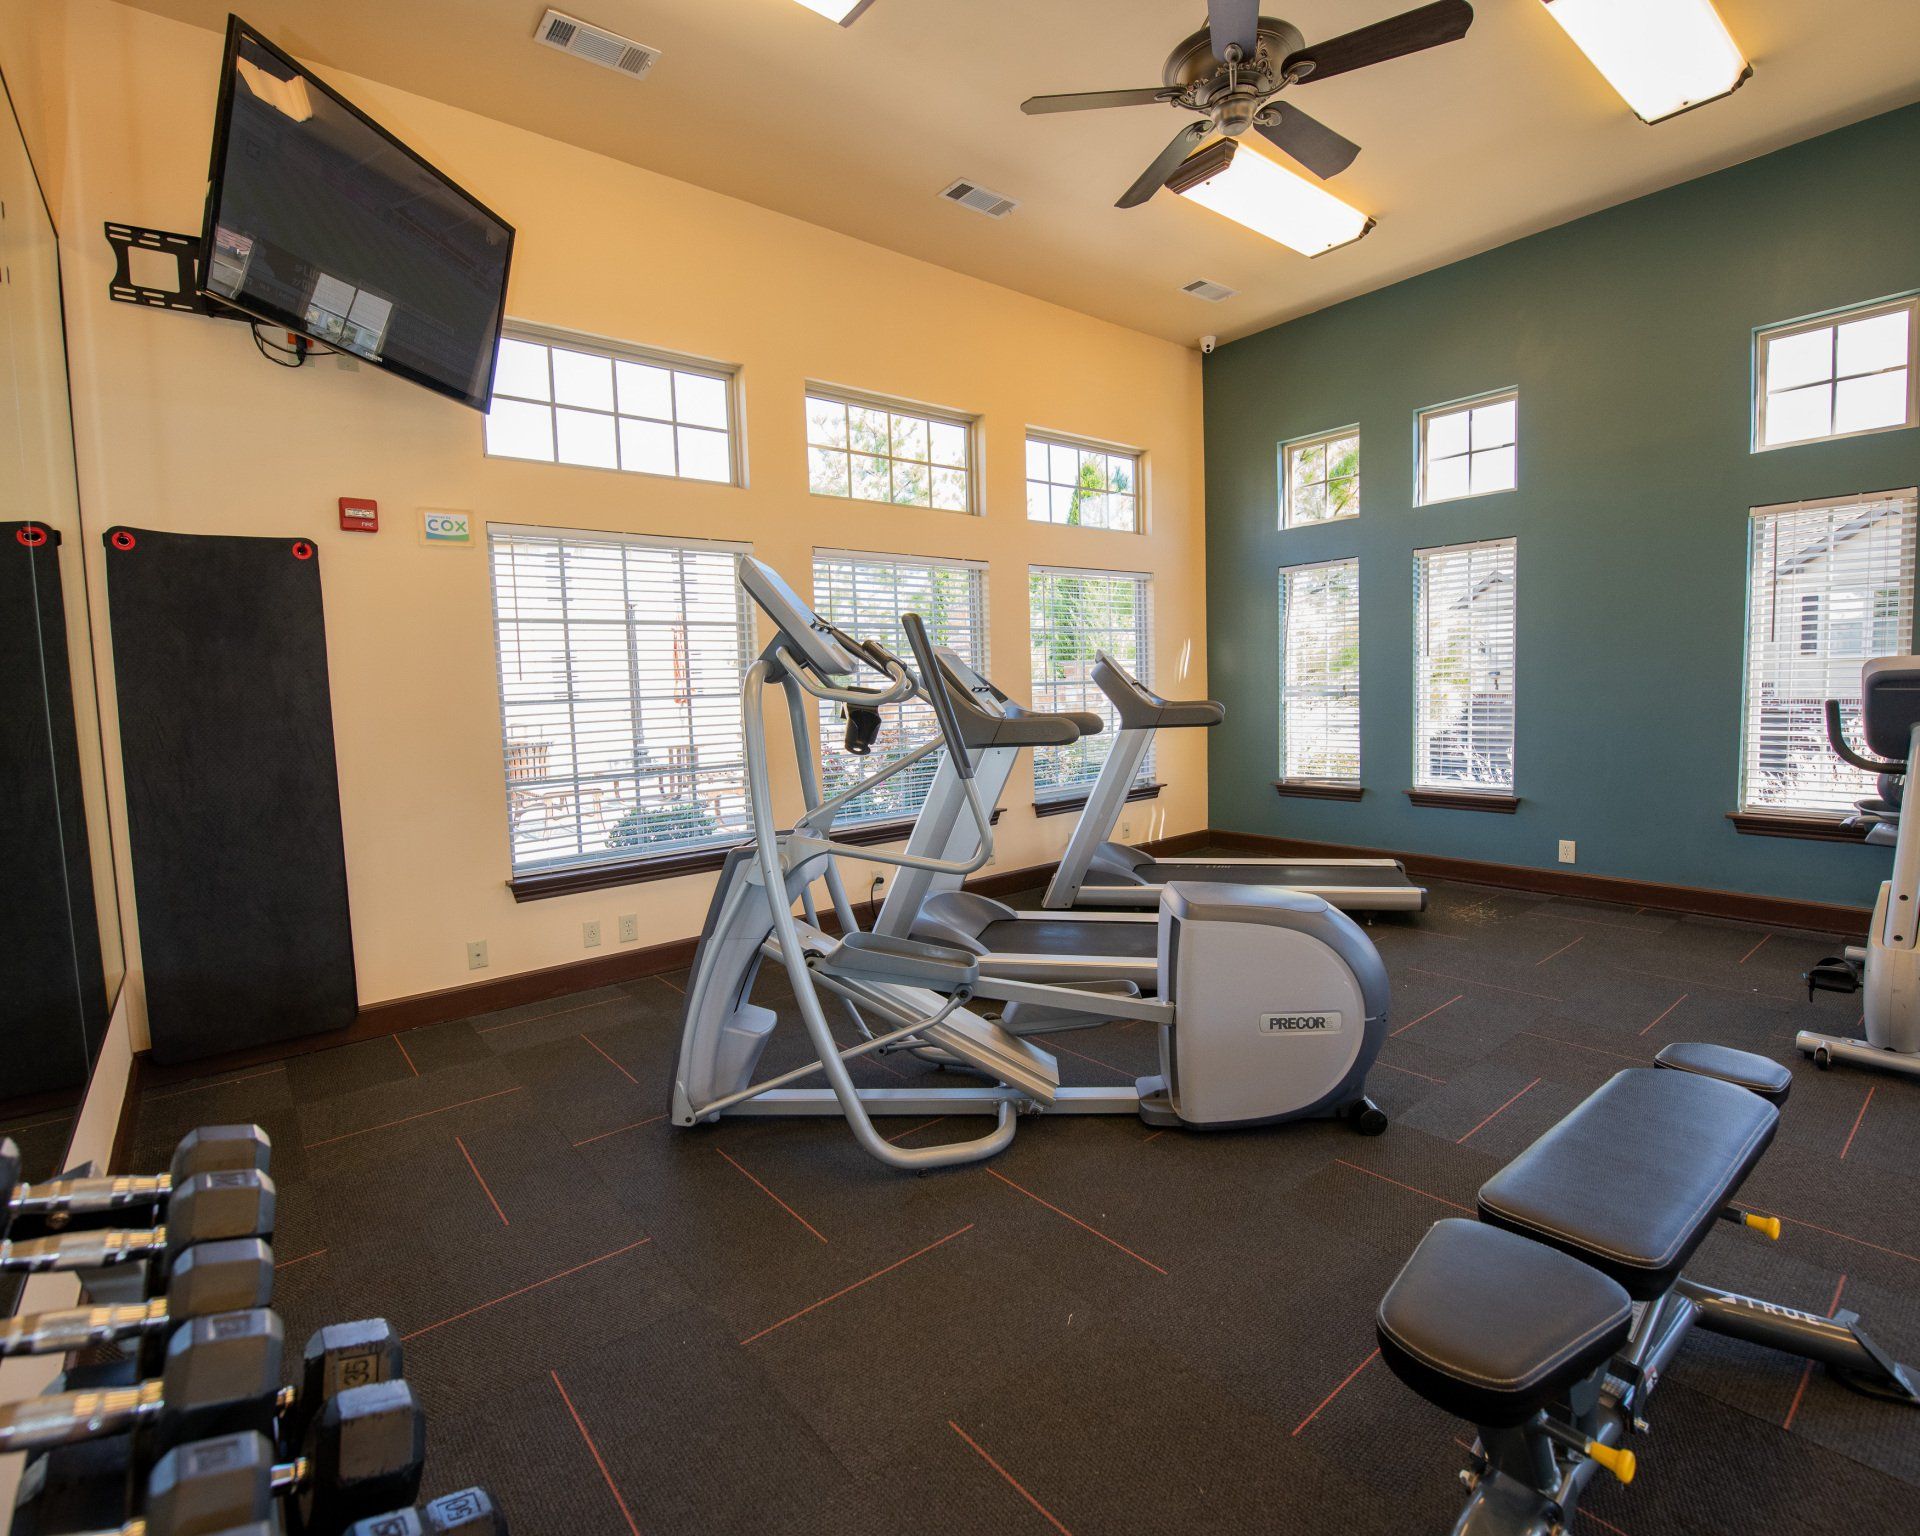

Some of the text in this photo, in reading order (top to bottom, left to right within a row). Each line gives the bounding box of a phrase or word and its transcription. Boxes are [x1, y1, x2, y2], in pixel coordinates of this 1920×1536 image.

[427, 519, 467, 532] COX
[1269, 1016, 1326, 1030] PRECOR
[1745, 1297, 1821, 1326] TRUE
[344, 1360, 370, 1386] 35
[445, 1498, 473, 1522] 50
